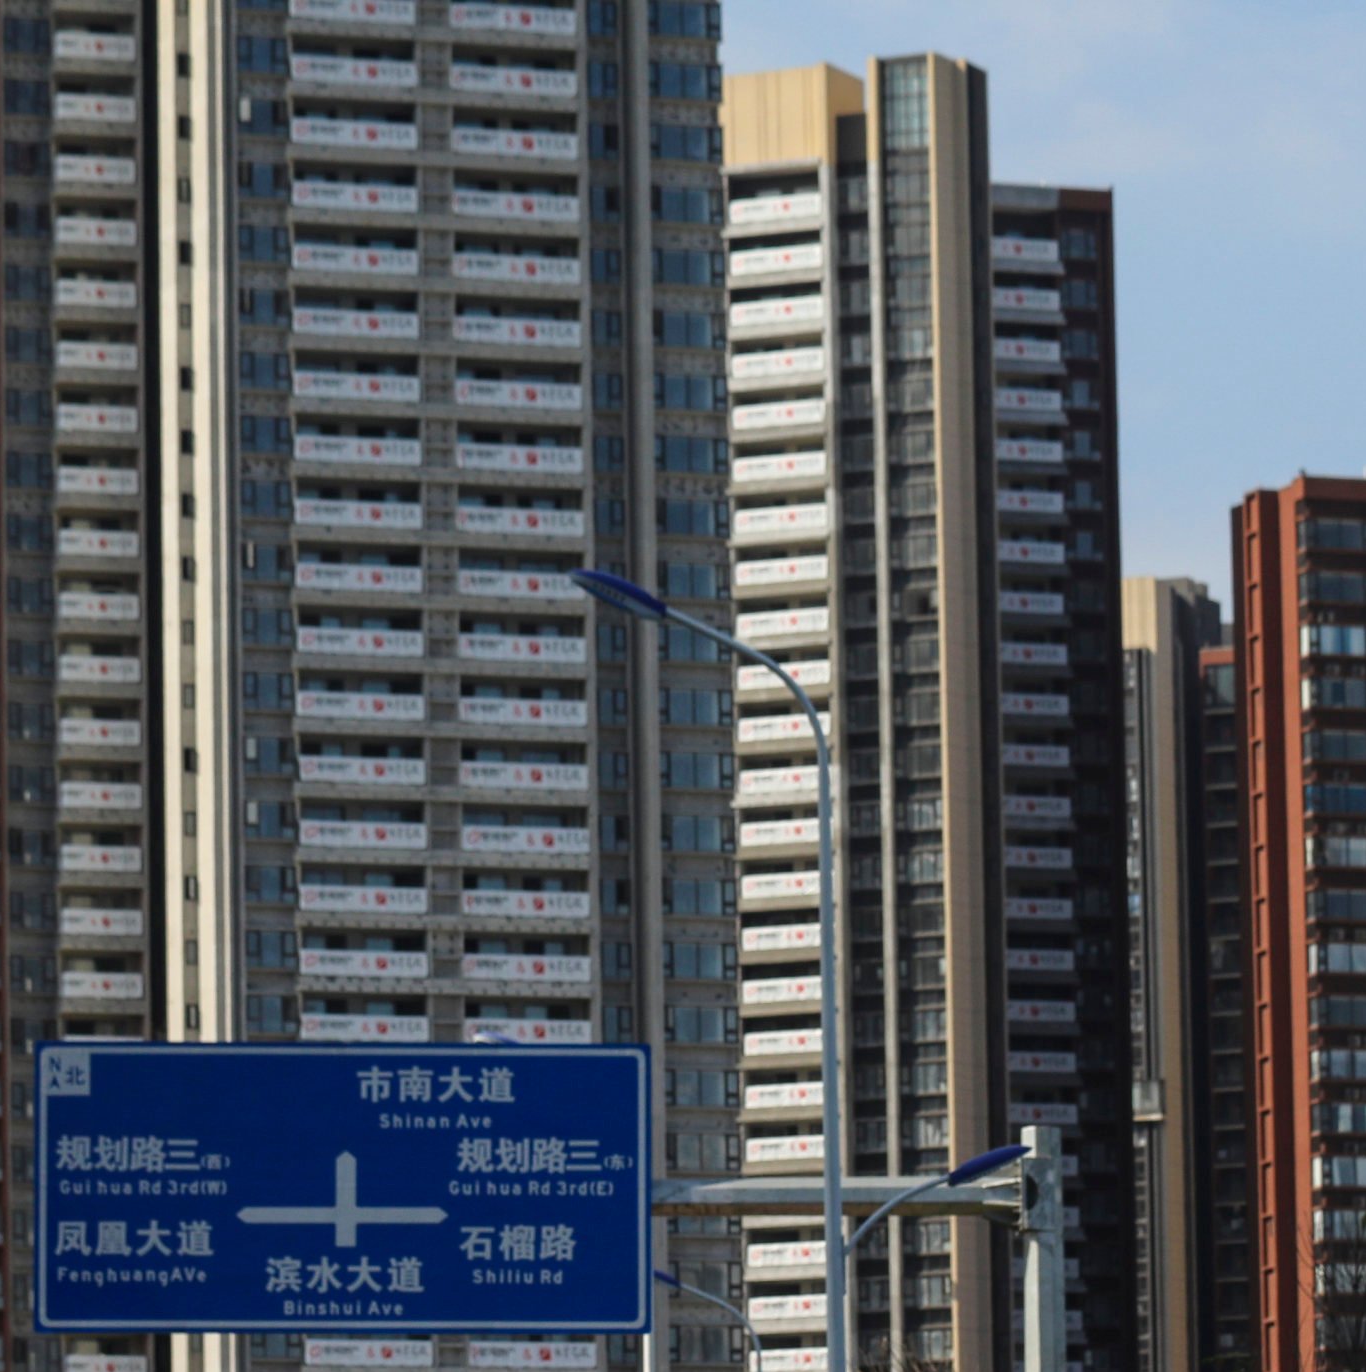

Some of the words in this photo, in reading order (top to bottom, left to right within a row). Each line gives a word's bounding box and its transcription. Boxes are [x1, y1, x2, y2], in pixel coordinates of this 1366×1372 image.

[66, 1065, 85, 1086] 北
[357, 1066, 515, 1103] 市南大道
[379, 1114, 448, 1128] Shinan
[457, 1114, 492, 1128] Ave
[139, 1180, 162, 1195] Rd
[168, 1180, 228, 1195] 3rd(W)
[528, 1180, 551, 1195] Rd
[557, 1180, 614, 1196] 3rd(E)
[55, 1220, 214, 1256] 凤凰大道
[460, 1224, 577, 1261] 石榴路
[265, 1257, 425, 1293] 滨水大道
[472, 1269, 534, 1284] Shiliu
[540, 1269, 563, 1284] Rd
[284, 1301, 362, 1316] Binshui
[369, 1301, 404, 1316] Ave
